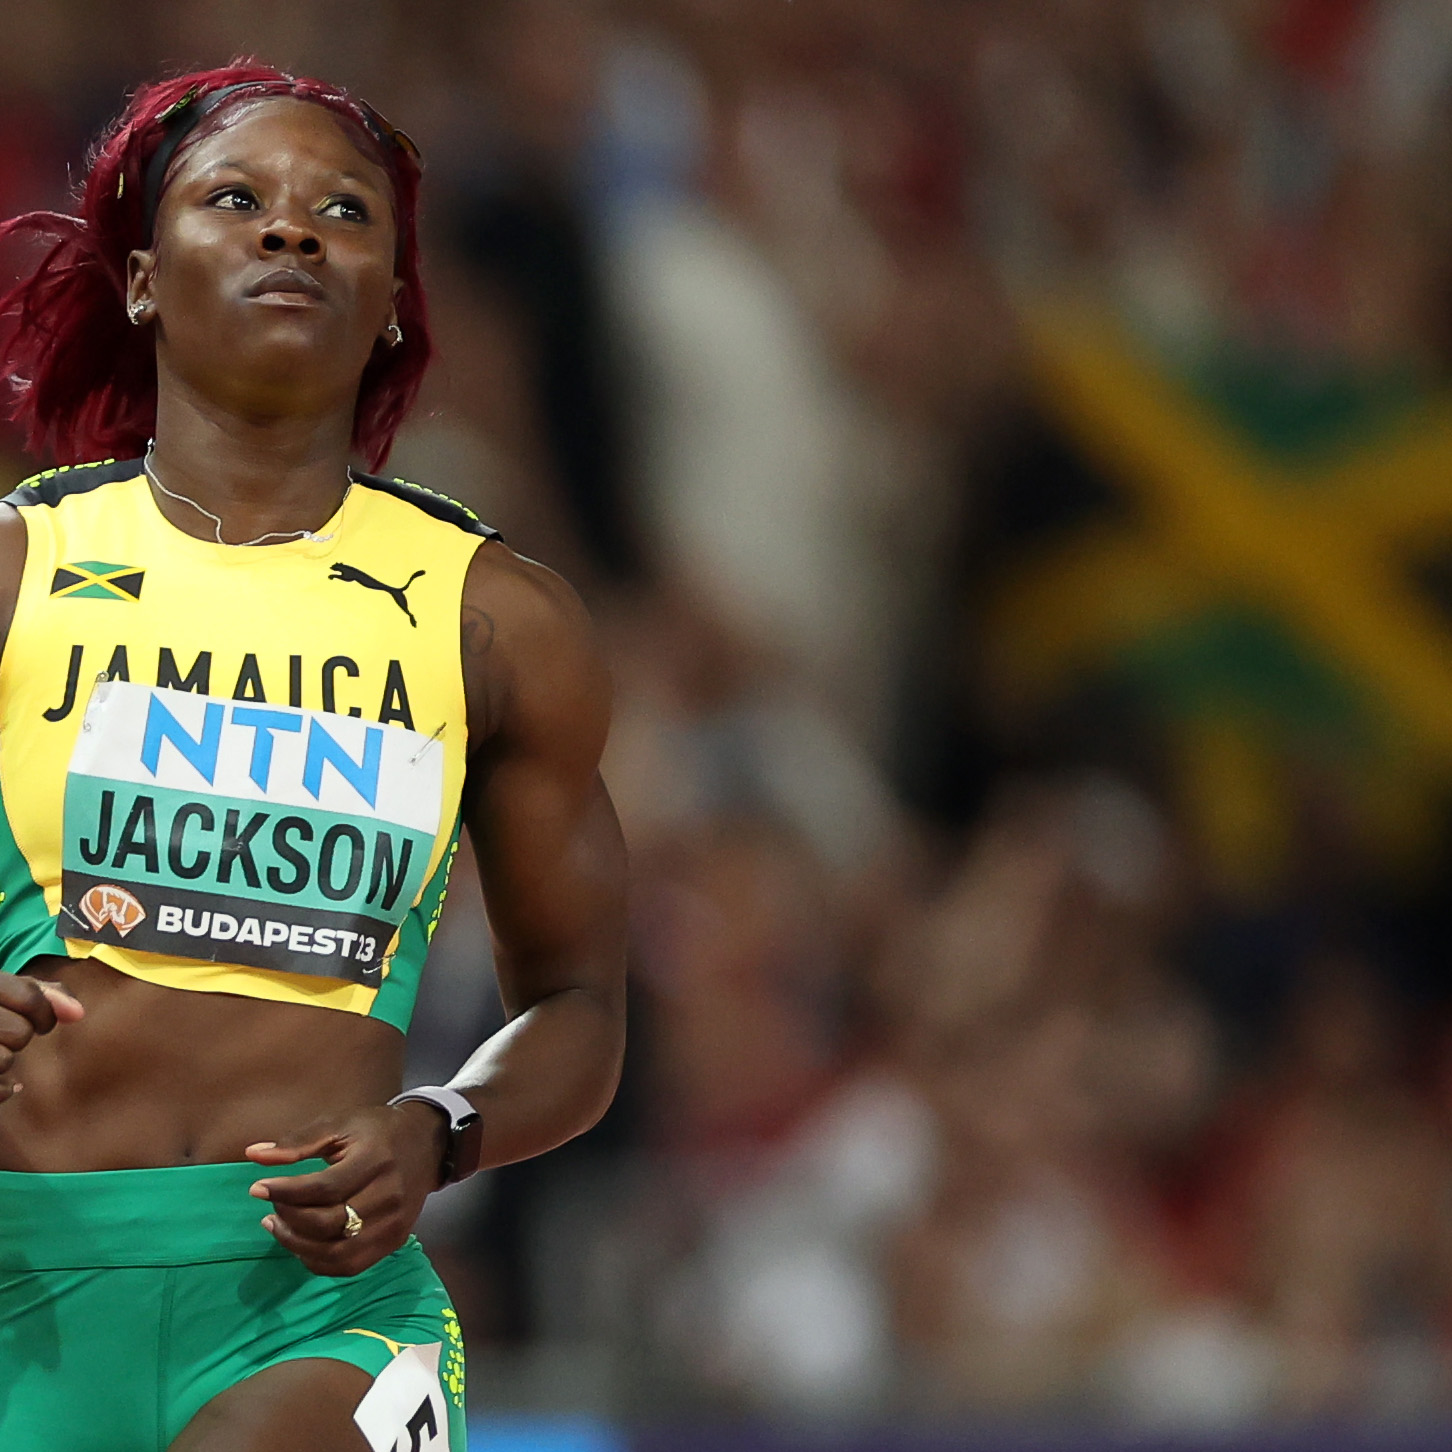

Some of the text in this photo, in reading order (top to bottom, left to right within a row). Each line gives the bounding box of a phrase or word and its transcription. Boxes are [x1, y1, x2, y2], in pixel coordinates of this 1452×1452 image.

[139, 690, 384, 811] NTN
[78, 789, 414, 912] JACKSON
[156, 905, 358, 958] BUDAPEST
